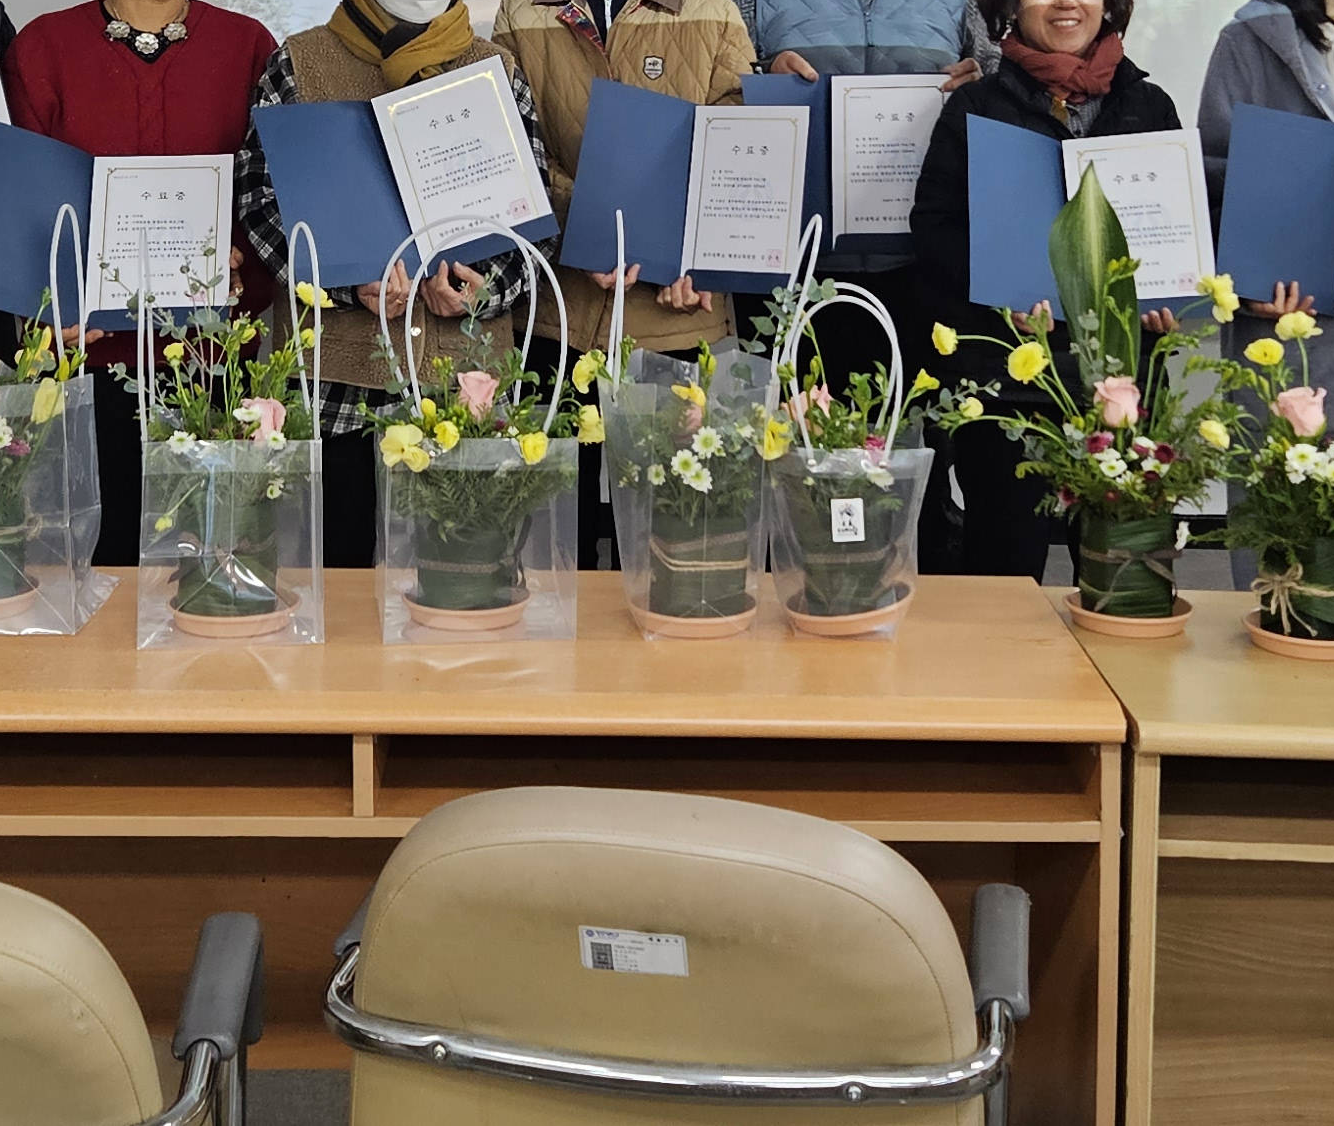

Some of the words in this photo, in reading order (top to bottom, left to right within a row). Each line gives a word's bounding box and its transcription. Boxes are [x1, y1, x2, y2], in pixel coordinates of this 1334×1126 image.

[429, 108, 471, 130] 수료증
[875, 112, 915, 123] 수료증
[732, 145, 769, 155] 수료증
[141, 191, 186, 201] 수료증
